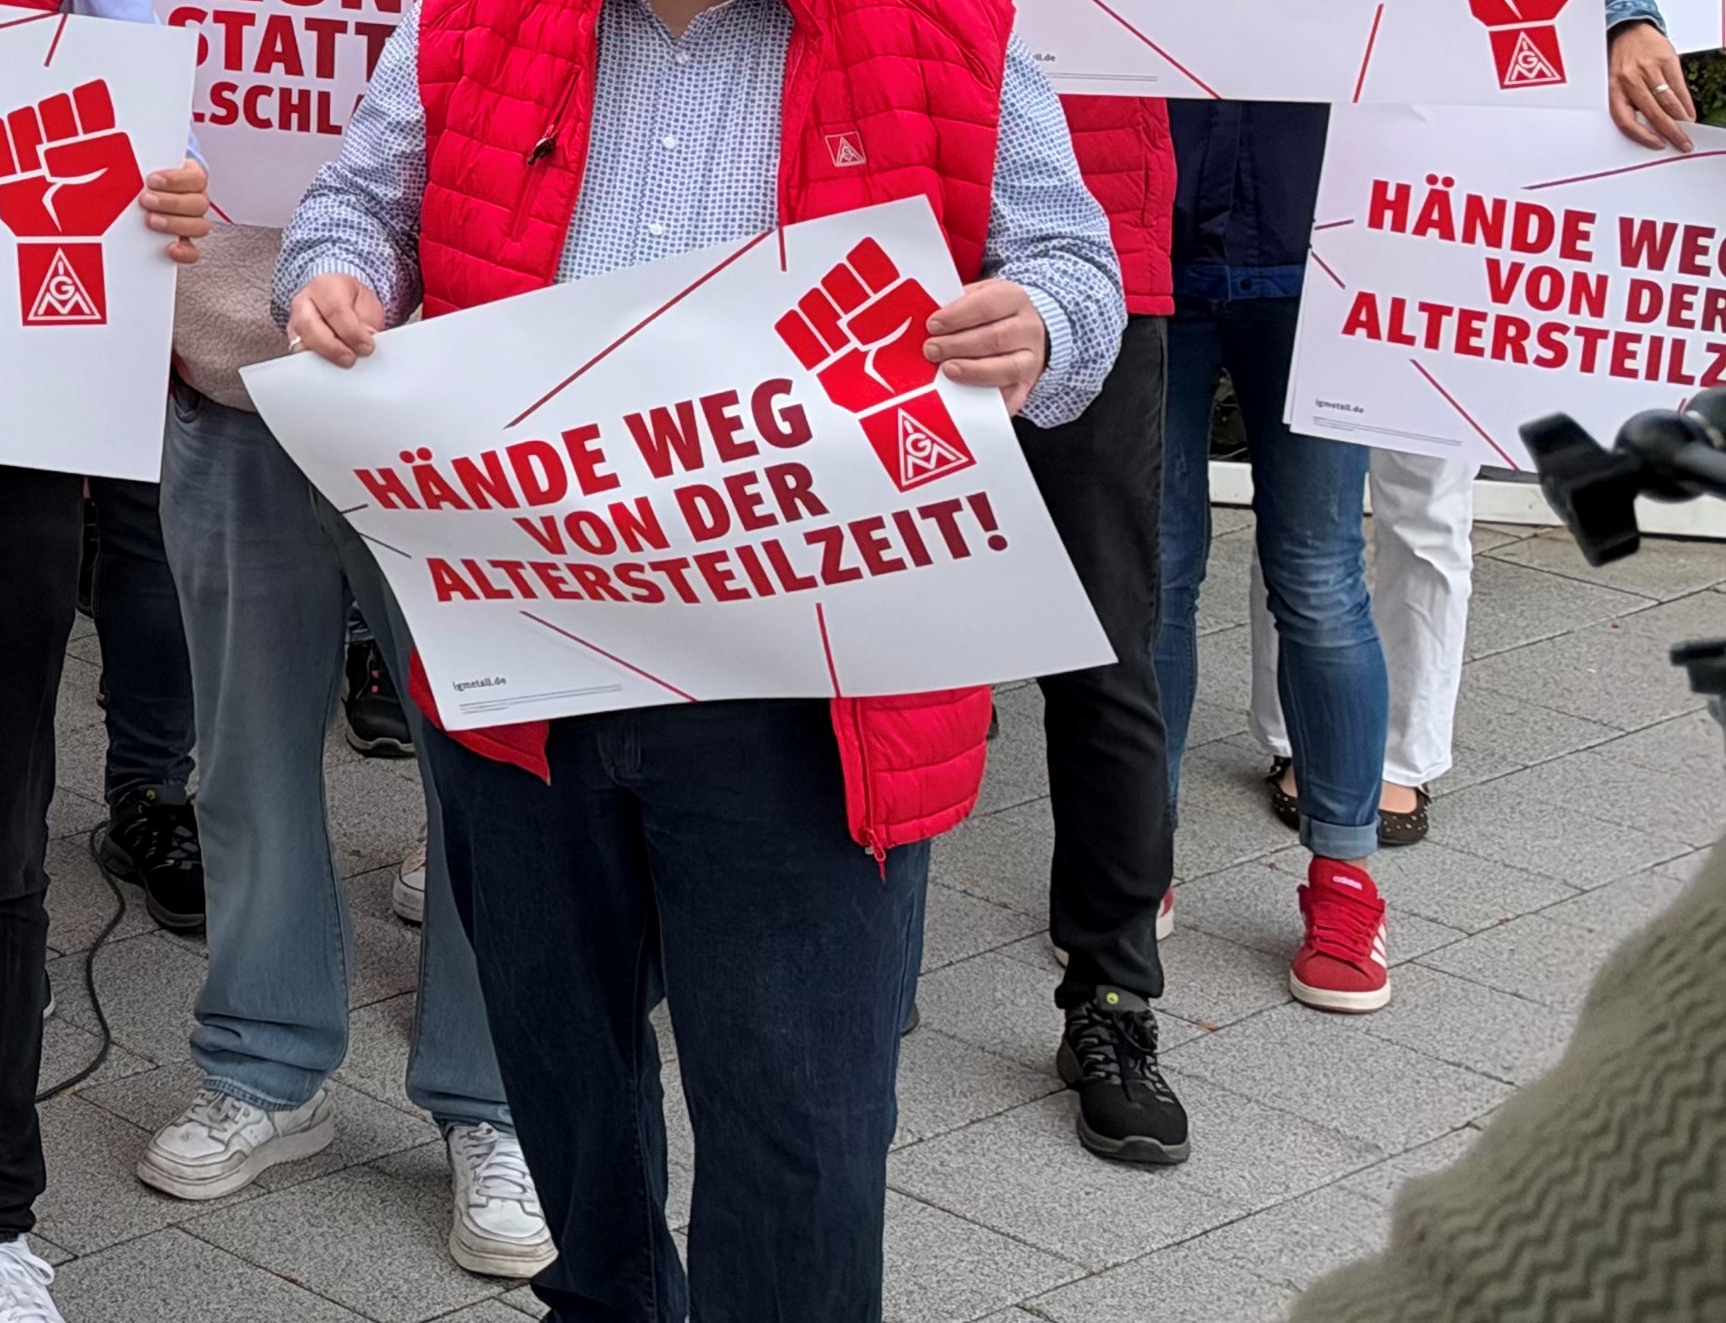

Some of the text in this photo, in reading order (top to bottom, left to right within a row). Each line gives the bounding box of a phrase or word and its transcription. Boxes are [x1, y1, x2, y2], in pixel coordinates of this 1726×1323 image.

[1505, 31, 1561, 86] IGM
[1368, 175, 1726, 275] HÄNDE WE
[29, 248, 103, 323] IGM
[1487, 258, 1607, 317] VON
[355, 379, 811, 509] HÄNDE WEG
[428, 492, 1008, 604] ALTERSTEILZEIT!
[514, 463, 826, 555] VON DER
